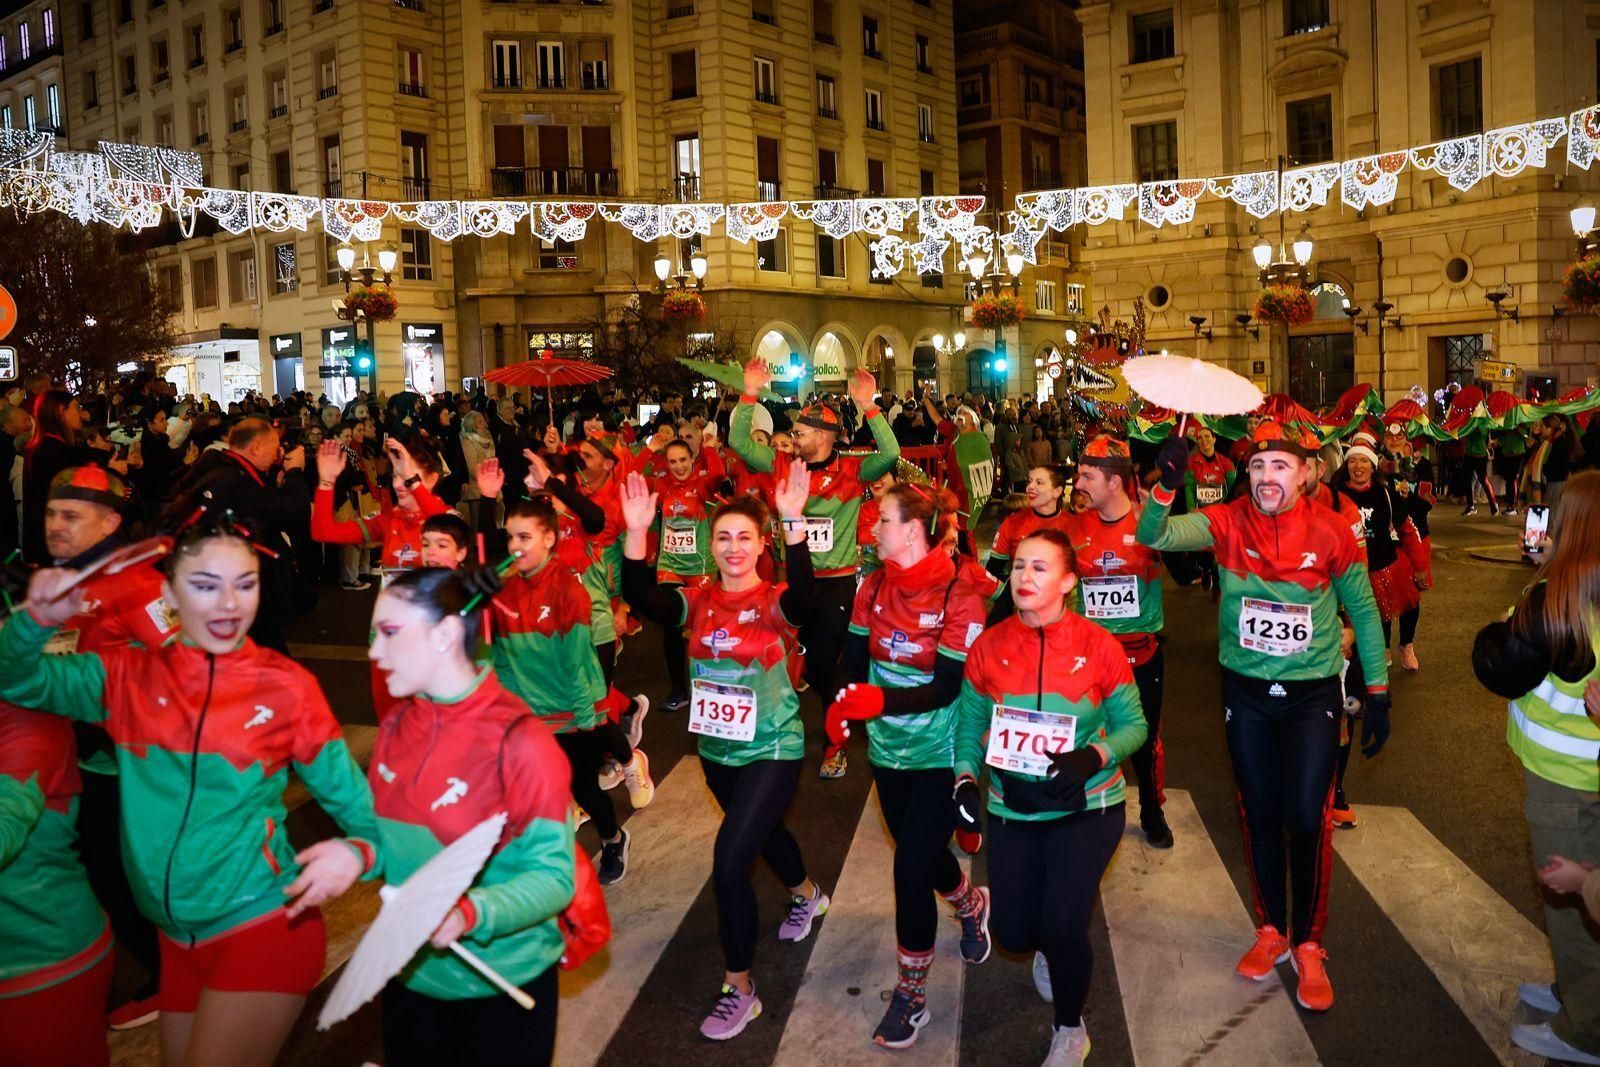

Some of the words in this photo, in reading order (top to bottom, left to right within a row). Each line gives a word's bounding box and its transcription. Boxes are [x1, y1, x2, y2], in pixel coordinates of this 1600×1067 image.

[666, 534, 694, 547] 1379
[1088, 590, 1136, 606] 1704
[1245, 617, 1308, 641] 1236
[696, 698, 752, 724] 1397
[998, 728, 1068, 756] 1707
